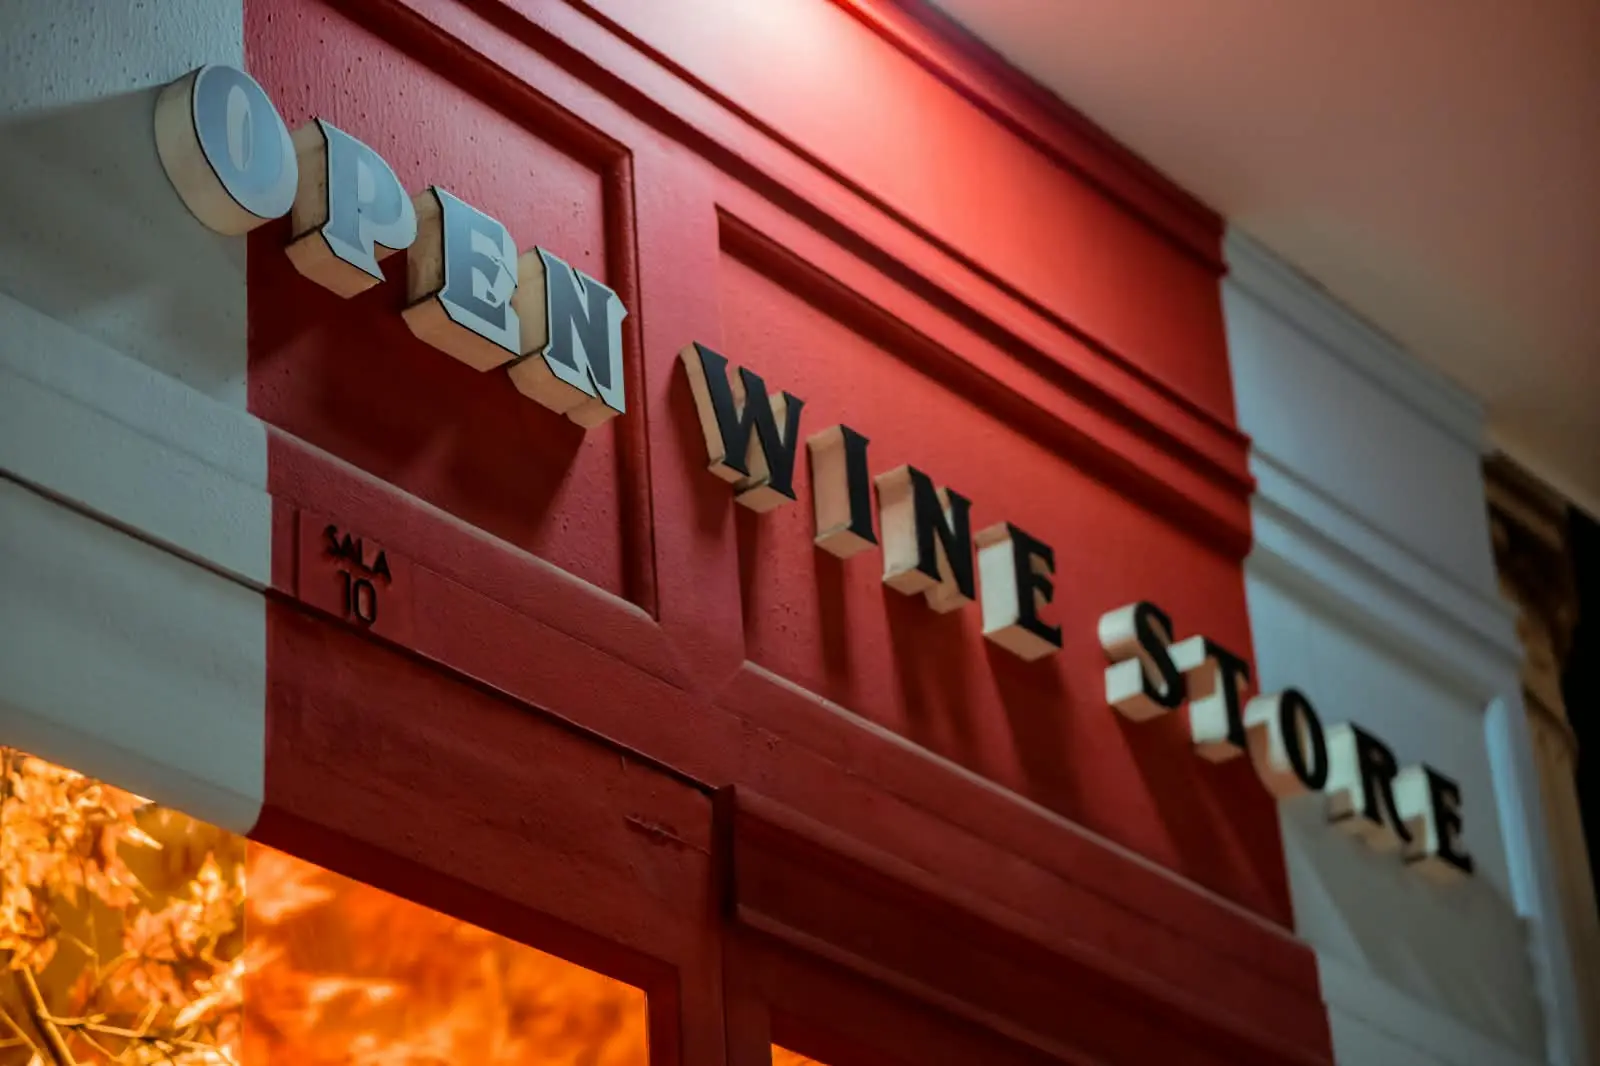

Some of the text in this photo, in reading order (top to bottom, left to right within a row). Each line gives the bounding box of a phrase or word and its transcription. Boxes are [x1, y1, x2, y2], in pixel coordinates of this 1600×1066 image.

[186, 65, 1473, 875] OPEN WINE STORE
[323, 524, 392, 584] SALA
[337, 569, 377, 625] 10
